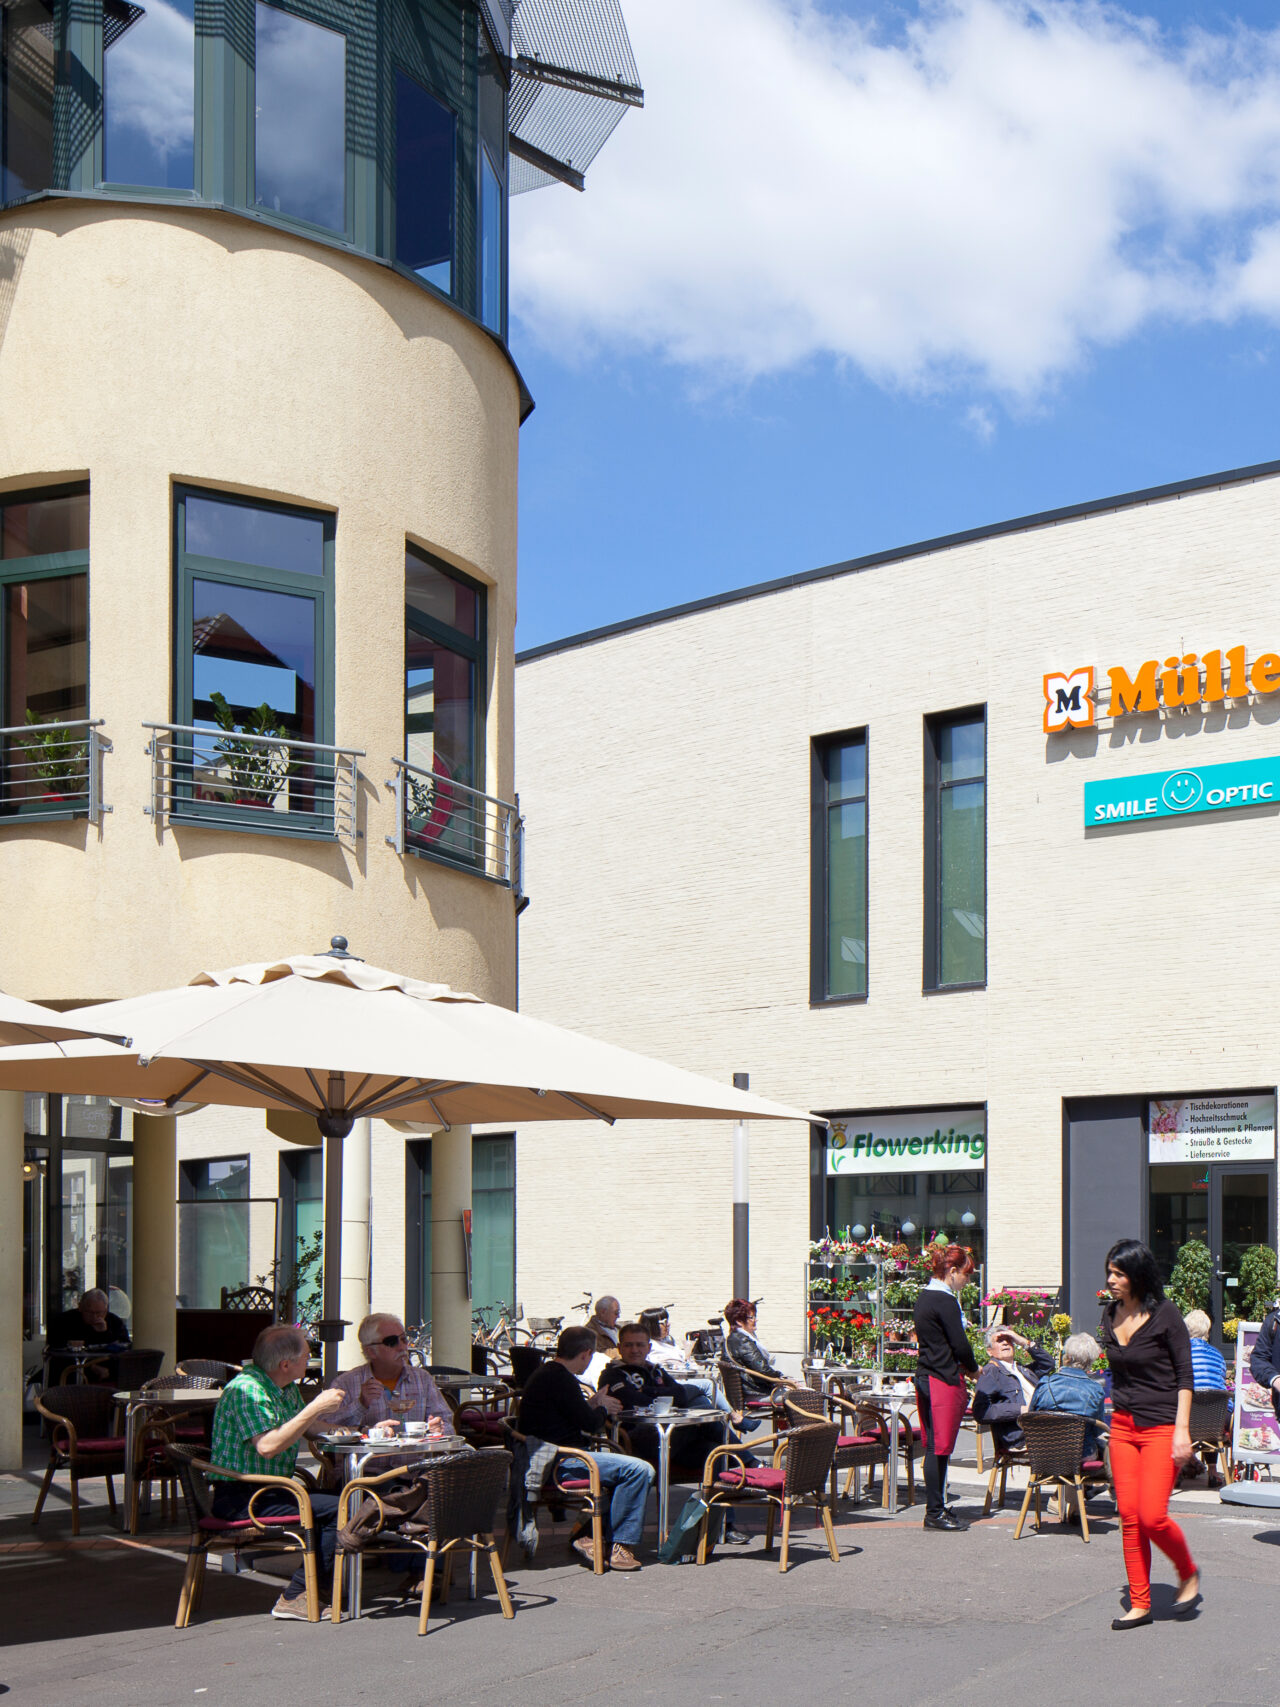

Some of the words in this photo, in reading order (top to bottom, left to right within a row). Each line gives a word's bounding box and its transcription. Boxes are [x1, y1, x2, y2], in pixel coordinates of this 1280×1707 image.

[1094, 798, 1158, 821] SMILE
[1206, 781, 1274, 806] OPTIC
[1190, 1102, 1249, 1111] Tischdekorationen
[1190, 1112, 1248, 1123] Hochzeitsschmuck
[1190, 1126, 1236, 1134] Schnittblumen
[1244, 1123, 1273, 1132] Pflanzen
[853, 1128, 985, 1159] Flowerking
[1223, 1136, 1253, 1146] Gestecke
[1190, 1151, 1231, 1159] Lieferservice
